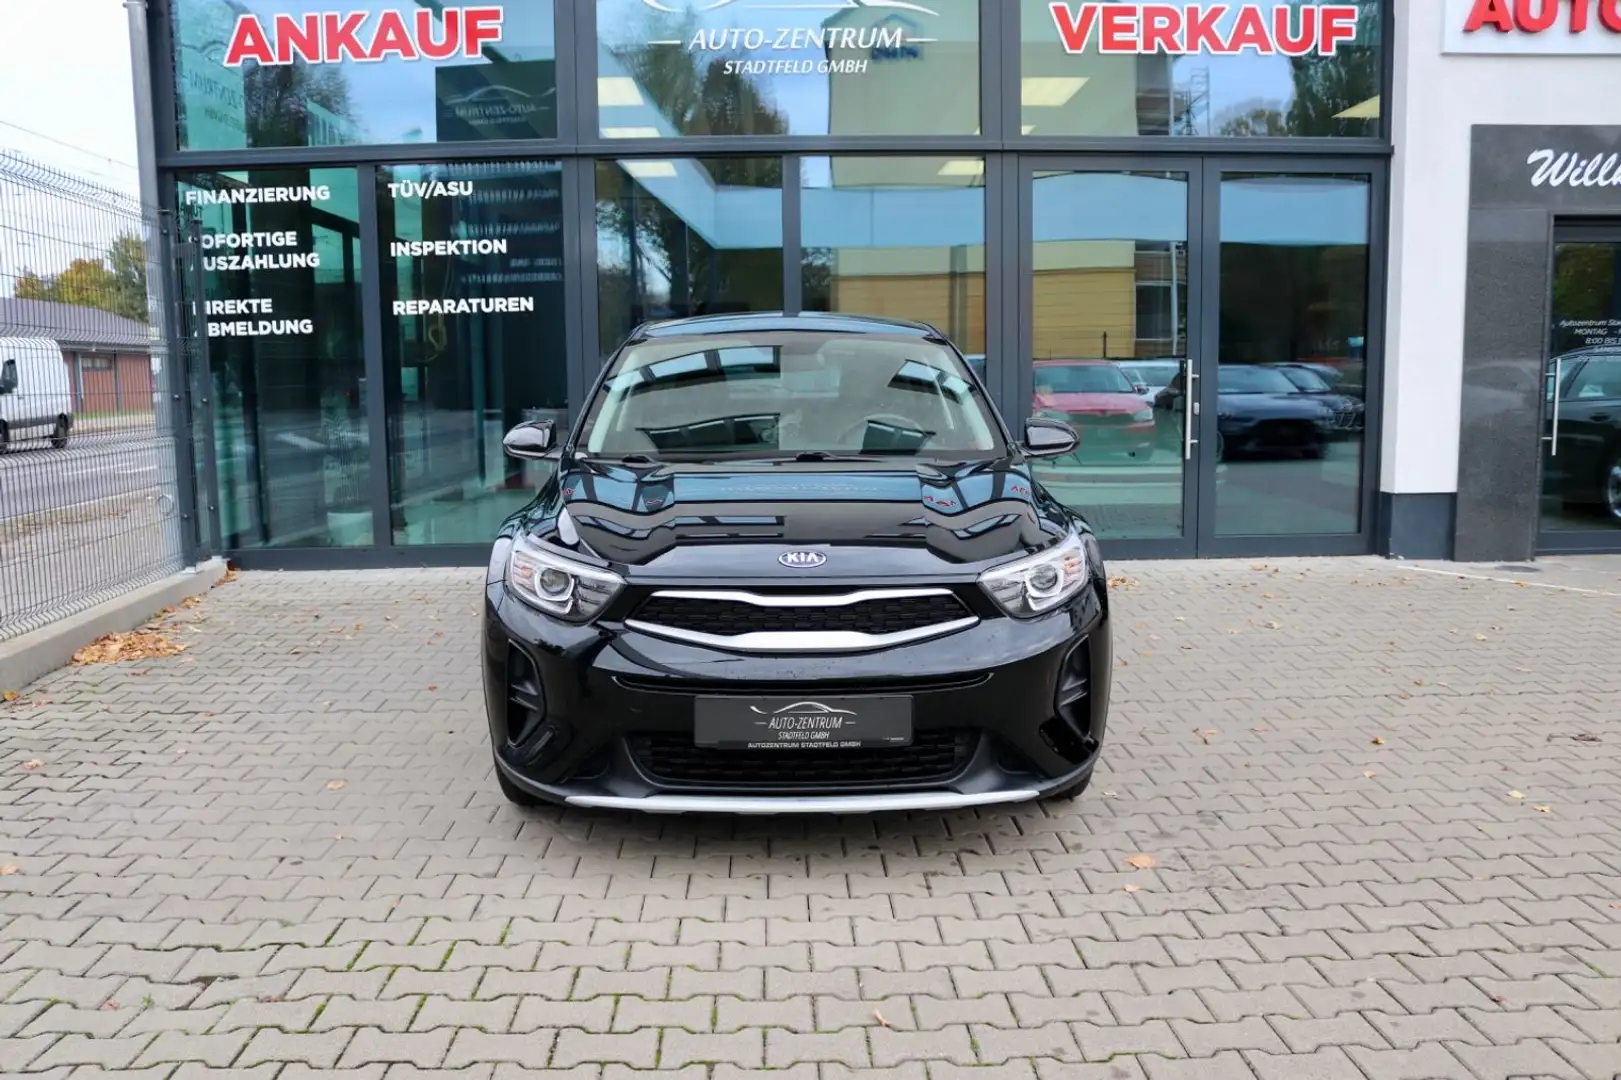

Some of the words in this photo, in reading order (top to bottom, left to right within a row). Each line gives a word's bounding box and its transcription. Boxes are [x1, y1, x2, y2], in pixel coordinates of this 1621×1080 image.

[223, 7, 503, 67] ANKAUF
[688, 27, 903, 50] AUTO-ZENTRUM
[1049, 3, 1358, 56] VERKAUF
[723, 60, 813, 75] STADTFELD
[817, 59, 868, 73] GMBH
[185, 185, 331, 205] FINANZIERUNG
[387, 180, 473, 199] TÜV/ASU
[188, 231, 297, 249] OFORTIGE
[390, 239, 507, 257] INSPEKTION
[190, 252, 320, 271] USZAHLUNG
[193, 298, 273, 315] IREKTE
[392, 297, 534, 315] REPARATUREN
[194, 319, 313, 337] BMELDUNG
[1574, 328, 1608, 336] MONTAG
[787, 552, 819, 563] KIA
[768, 716, 843, 730] AUTO-ZENTRUM
[778, 731, 810, 740] STADTFELD
